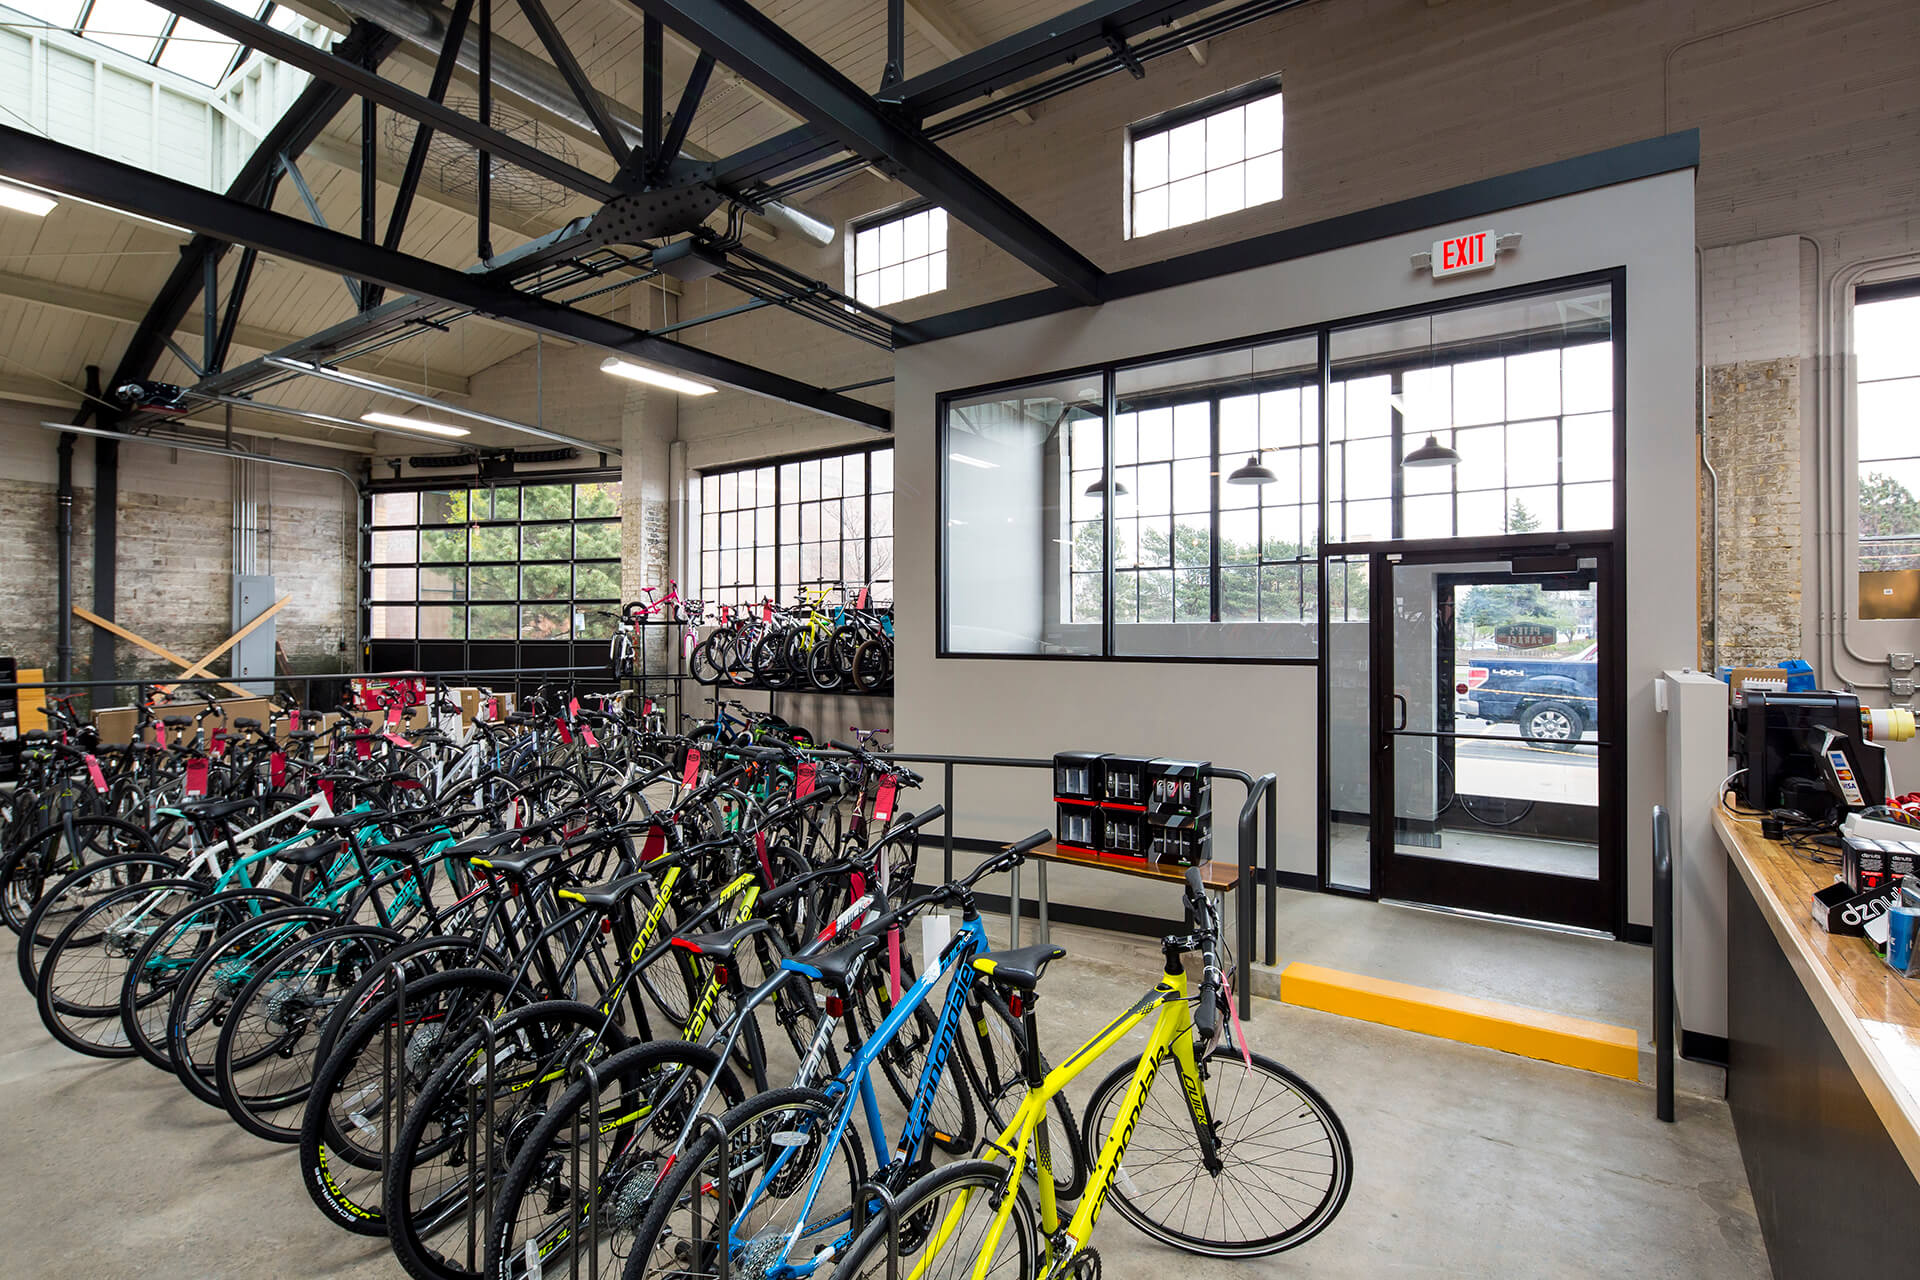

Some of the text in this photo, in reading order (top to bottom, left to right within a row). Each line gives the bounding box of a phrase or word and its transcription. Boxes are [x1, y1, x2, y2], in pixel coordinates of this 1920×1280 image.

[1443, 233, 1486, 270] EXIT
[631, 885, 673, 965] ondale
[911, 961, 975, 1147] cannondale
[1090, 1045, 1168, 1226] cannondale
[1183, 1072, 1208, 1126] QUICK
